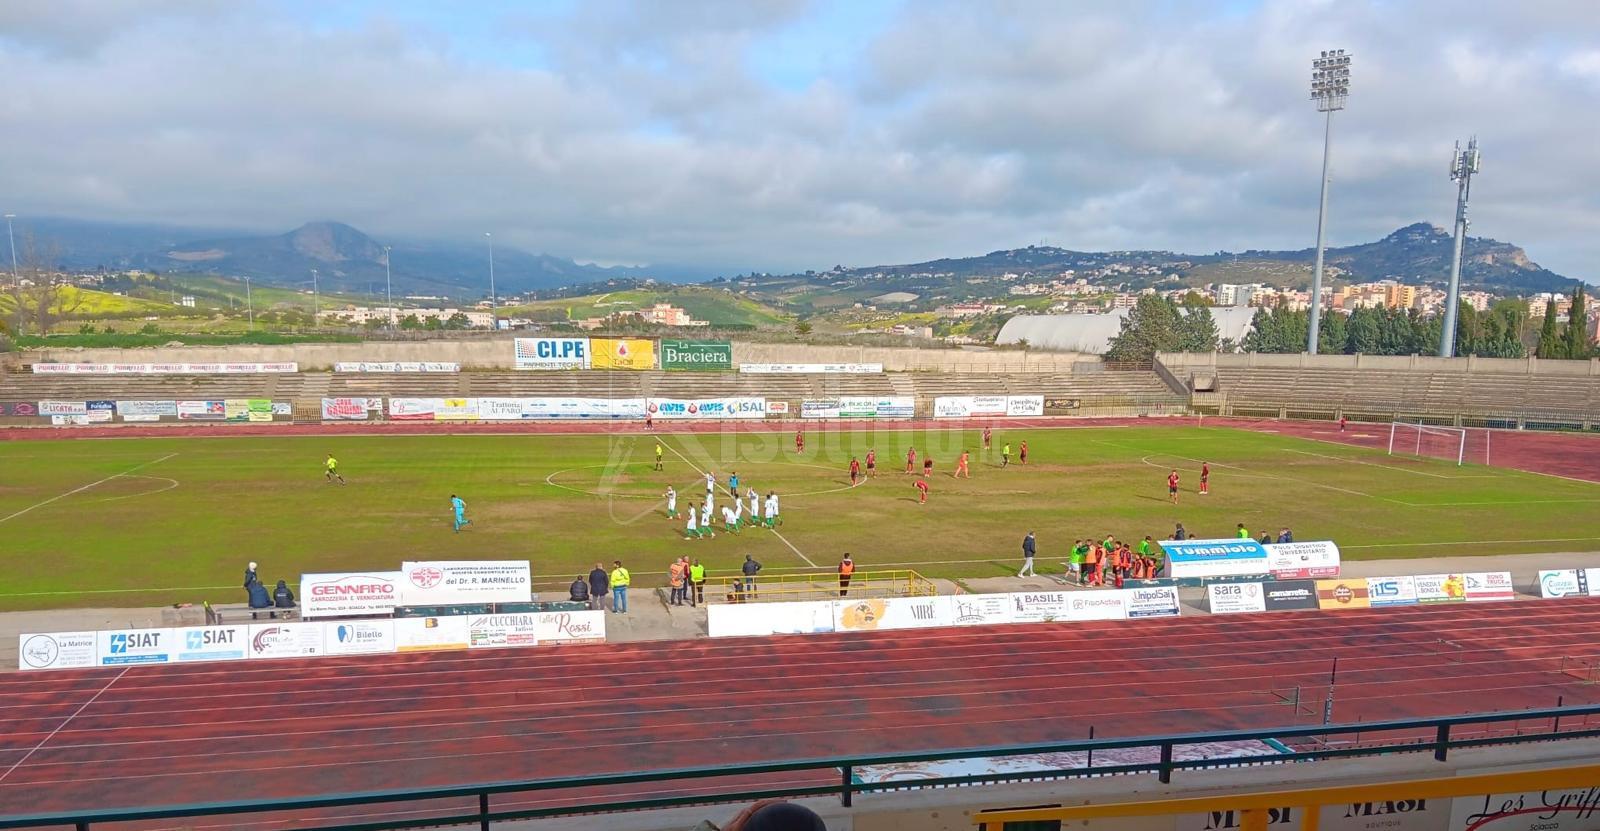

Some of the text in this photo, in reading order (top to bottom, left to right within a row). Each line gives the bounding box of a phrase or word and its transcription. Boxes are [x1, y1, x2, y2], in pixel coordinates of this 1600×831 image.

[537, 341, 585, 358] CI.PE
[667, 349, 729, 364] Braciera
[660, 403, 686, 411] AVIS
[699, 403, 724, 411] AVIS
[739, 402, 764, 412] ISAL
[1171, 545, 1256, 556] Tummiolo
[1279, 548, 1326, 556] UNIVERSITARIO
[312, 584, 394, 595] GENNARO
[1134, 589, 1171, 601] UnipolSai
[1215, 585, 1241, 594] sara
[1025, 594, 1064, 602] BASILE
[490, 615, 533, 626] CUCCHIARA
[555, 613, 591, 638] Rossi
[203, 629, 235, 644] SIAT
[357, 630, 382, 638] Bilello
[128, 633, 161, 648] SIAT
[1343, 798, 1427, 818] MASI
[1465, 793, 1525, 826] Les
[1203, 807, 1291, 830] MSI
[1366, 820, 1401, 829] BOUTIQUE
